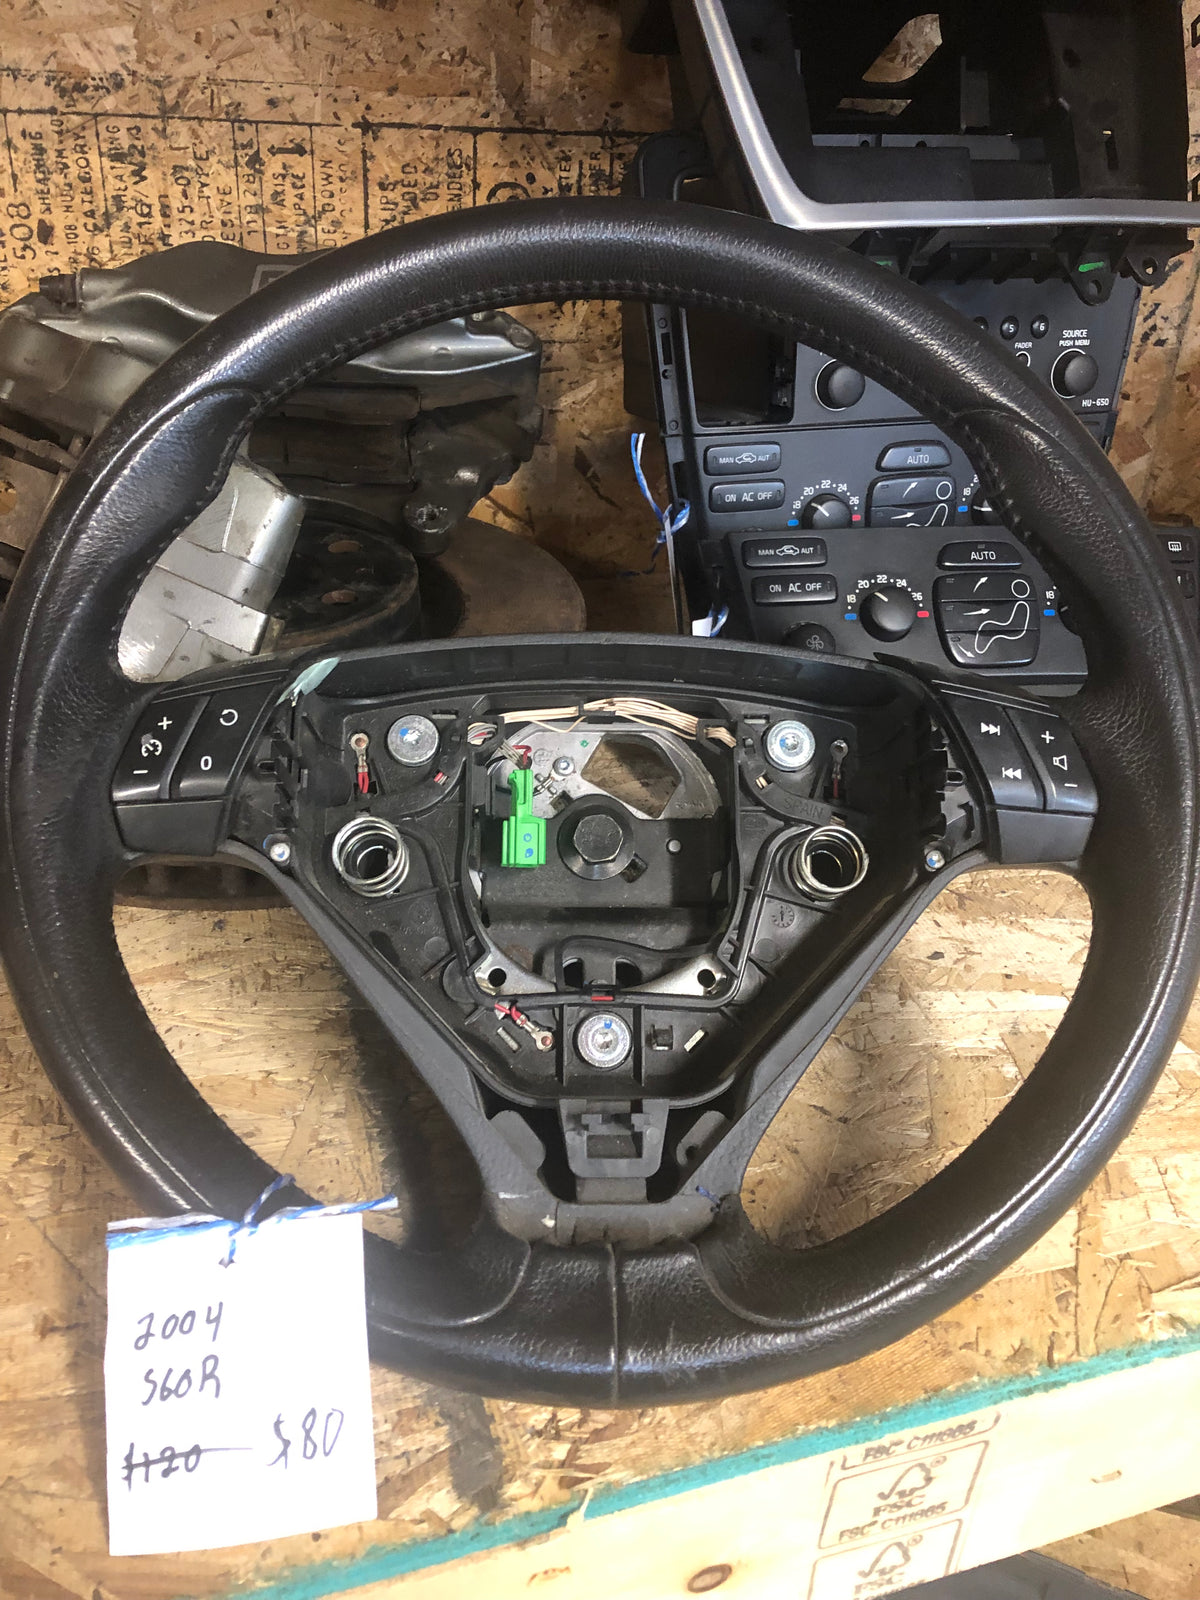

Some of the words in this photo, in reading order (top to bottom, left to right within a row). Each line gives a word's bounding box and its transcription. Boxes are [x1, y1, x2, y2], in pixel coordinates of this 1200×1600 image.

[320, 159, 335, 212] DOWN
[1009, 324, 1014, 333] 5
[1040, 322, 1045, 331] 6
[1062, 329, 1088, 338] SOURCE
[1082, 398, 1109, 407] HU-650
[758, 454, 770, 462] AUT
[907, 454, 930, 464] AUTO
[821, 480, 831, 489] 22
[837, 483, 847, 492] 24
[803, 487, 815, 496] 20
[963, 487, 972, 496] 18
[724, 494, 737, 502] ON
[741, 493, 754, 502] AC
[757, 492, 773, 500] OFF
[849, 497, 860, 505] 26
[792, 500, 801, 509] 18
[970, 551, 996, 560] AUTO
[876, 575, 888, 584] 22
[895, 578, 907, 587] 24
[769, 585, 782, 593] ON
[788, 583, 801, 593] AC
[805, 583, 822, 591] OFF
[857, 580, 870, 589] 20
[846, 594, 856, 604] 18
[911, 592, 923, 601] 26
[1045, 590, 1055, 599] 18
[785, 798, 824, 820] SPAIN
[134, 1301, 224, 1350] 2004
[266, 1407, 344, 1470] $80
[872, 1494, 926, 1518] FSC
